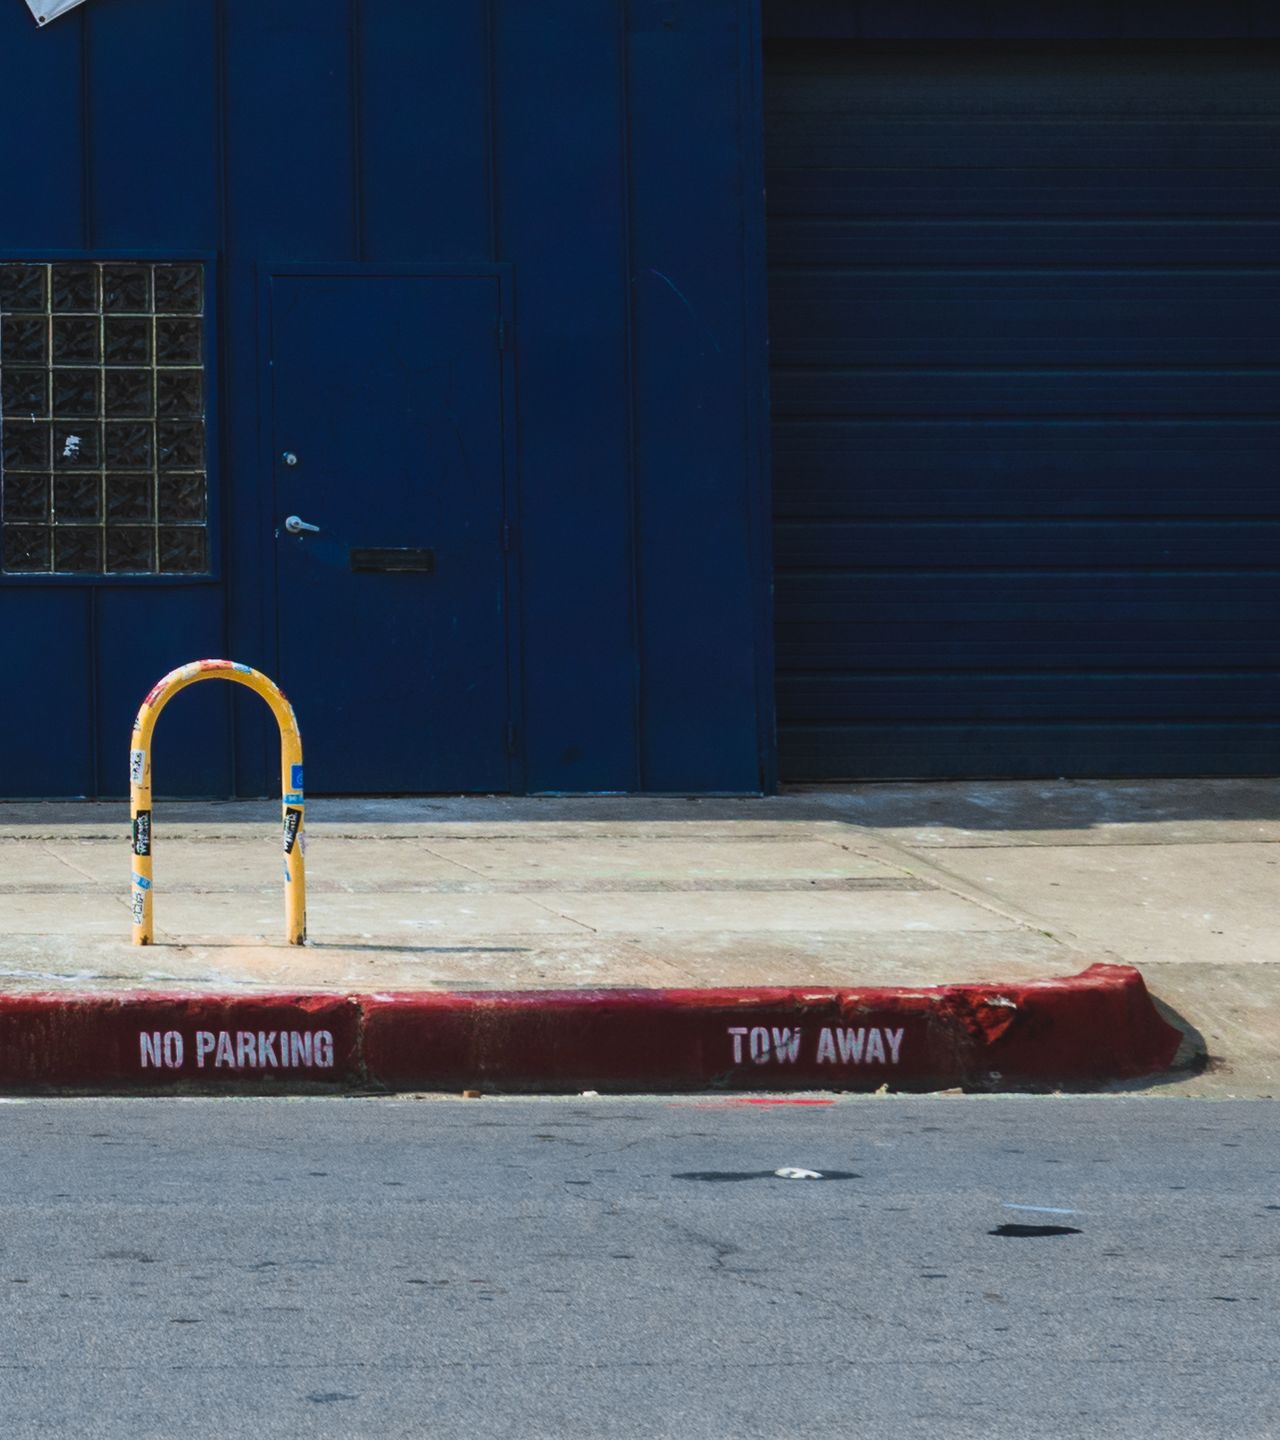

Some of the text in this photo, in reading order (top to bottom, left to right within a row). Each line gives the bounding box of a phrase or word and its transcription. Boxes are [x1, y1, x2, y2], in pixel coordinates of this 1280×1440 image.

[140, 1030, 334, 1068] NO PARKING
[727, 1027, 904, 1064] TOW AWAY
